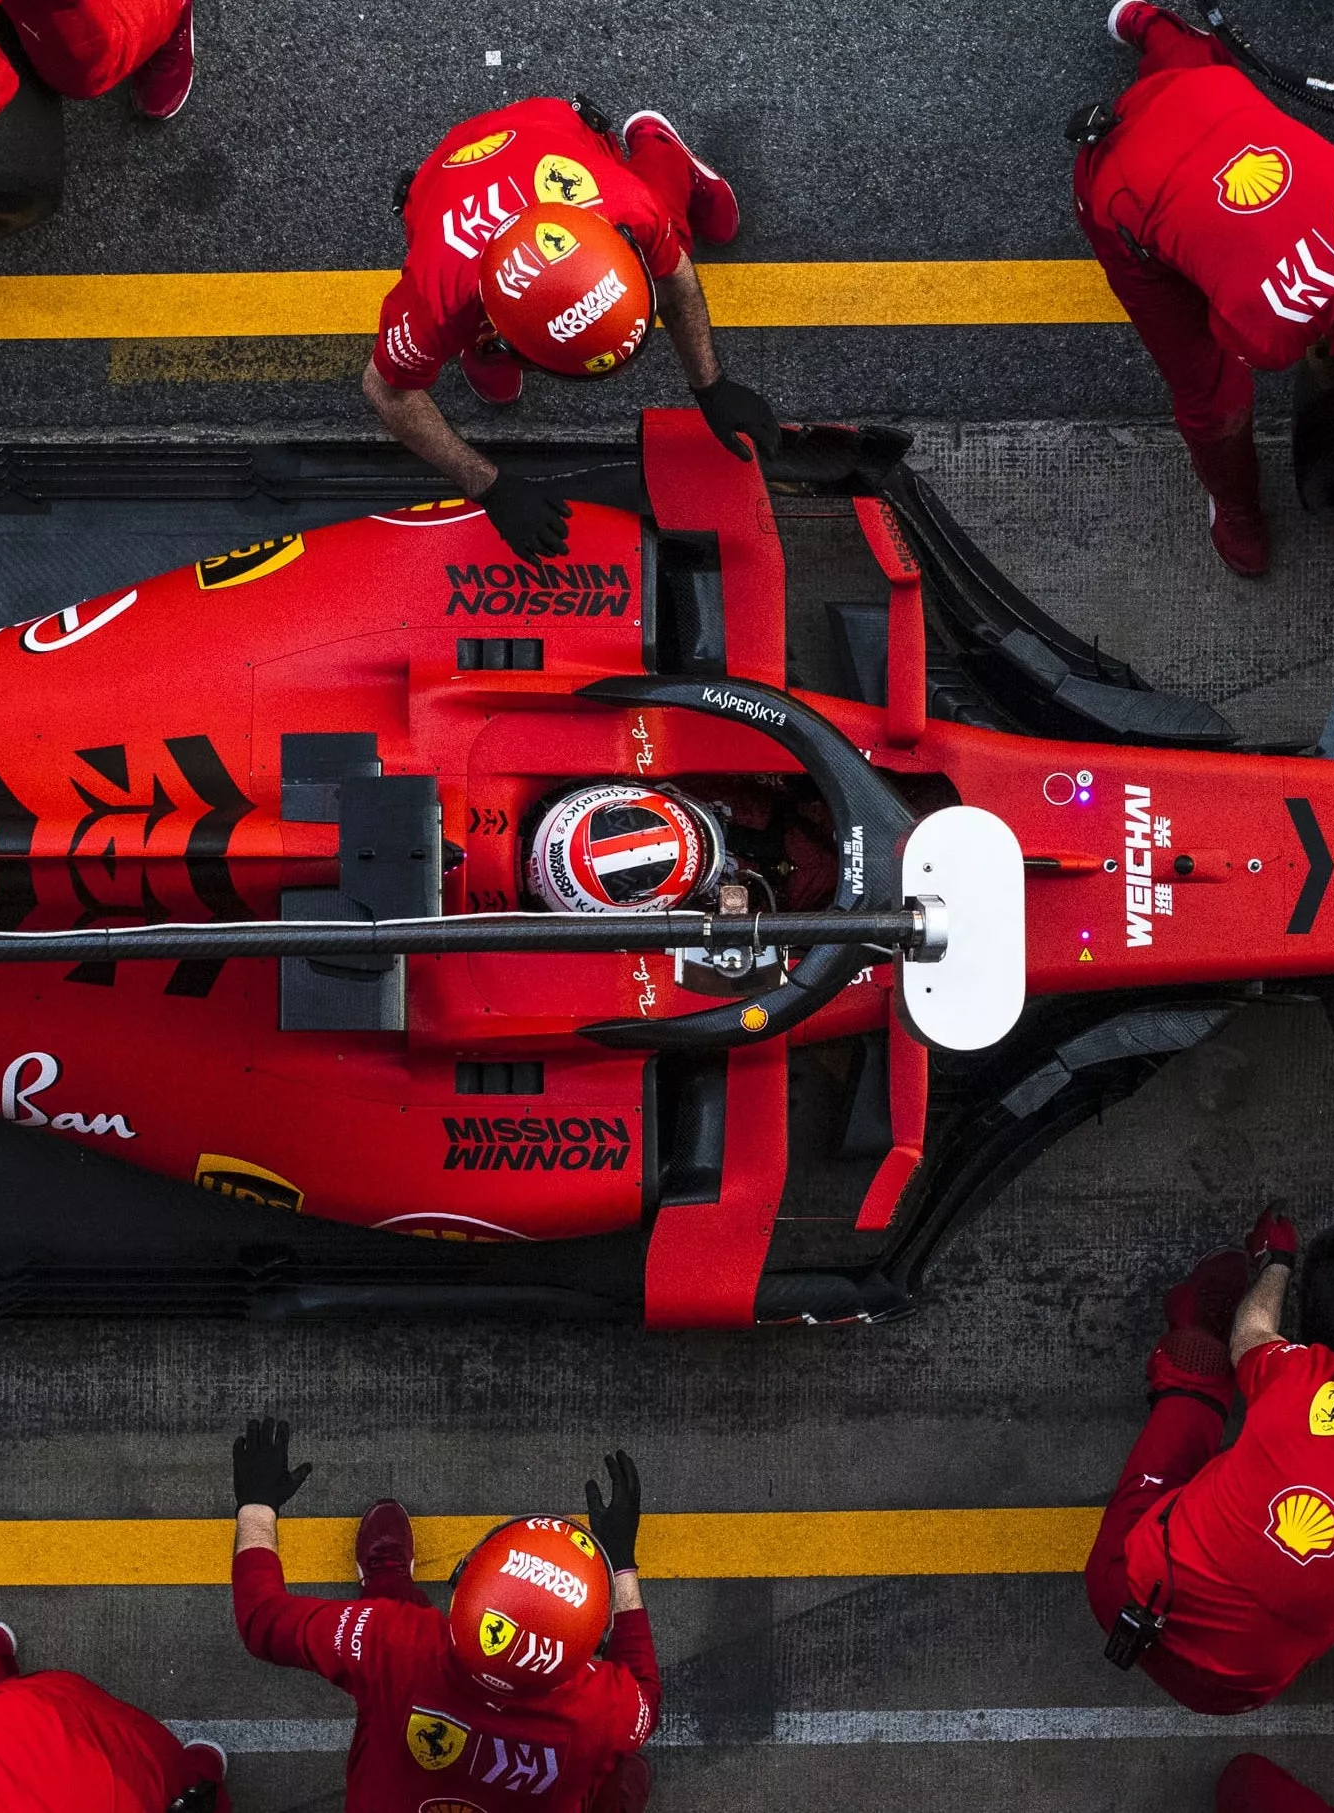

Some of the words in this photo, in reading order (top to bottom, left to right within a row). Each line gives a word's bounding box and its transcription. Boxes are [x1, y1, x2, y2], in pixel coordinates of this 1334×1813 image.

[547, 268, 619, 337] WINNOW
[552, 280, 627, 343] MISSION
[446, 564, 631, 590] WINNOW
[446, 592, 631, 617] MISSION
[702, 687, 778, 722] KASPERSKY
[633, 715, 654, 774] Ray-Ban
[563, 789, 641, 830] KASPERSKY
[550, 842, 574, 899] WINNOW
[554, 839, 578, 897] MISSION
[849, 826, 863, 895] WEICHAI
[1125, 784, 1155, 948] WEICHAI
[633, 956, 656, 1016] Ray-Ban
[442, 1117, 630, 1144] MISSION
[442, 1147, 630, 1171] WINNOW
[499, 1560, 587, 1608] WINNOW
[509, 1550, 587, 1599] MISSION
[351, 1608, 373, 1661] HUBLOT
